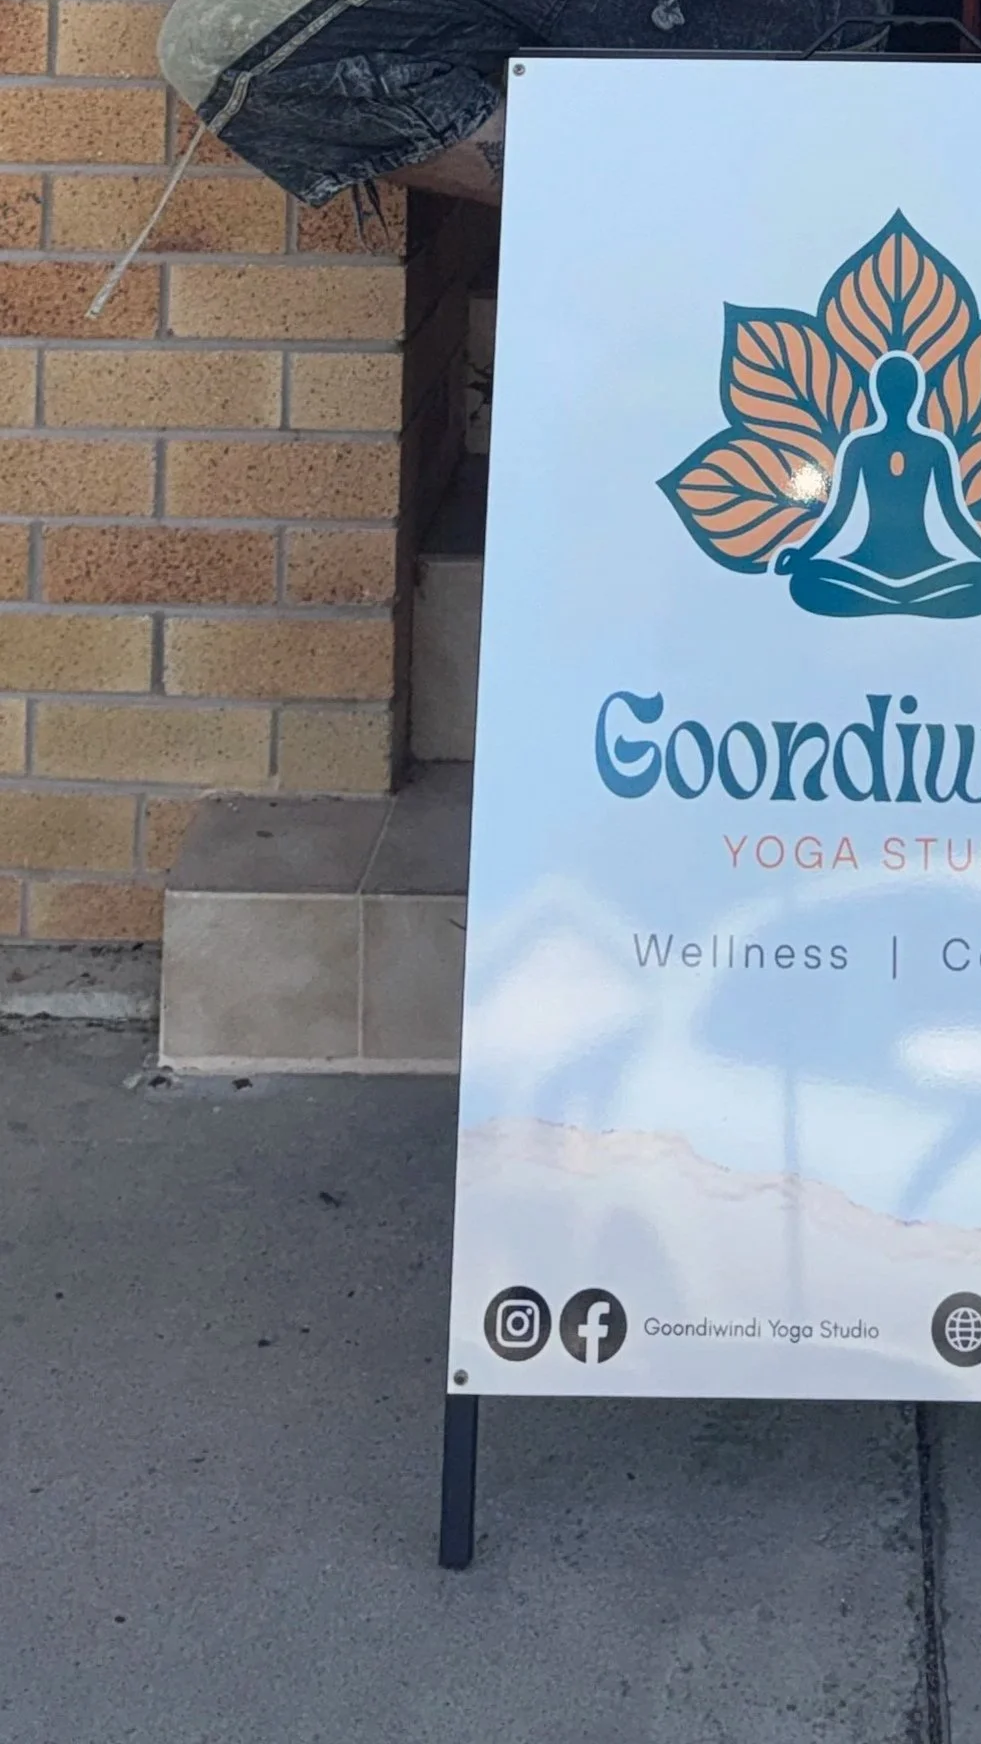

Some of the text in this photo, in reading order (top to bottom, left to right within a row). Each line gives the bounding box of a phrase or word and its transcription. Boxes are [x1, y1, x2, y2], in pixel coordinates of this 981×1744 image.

[723, 835, 859, 870] YOGA
[633, 933, 849, 970] Wellness
[643, 1316, 880, 1343] Goondiwindi Yoga Studio
